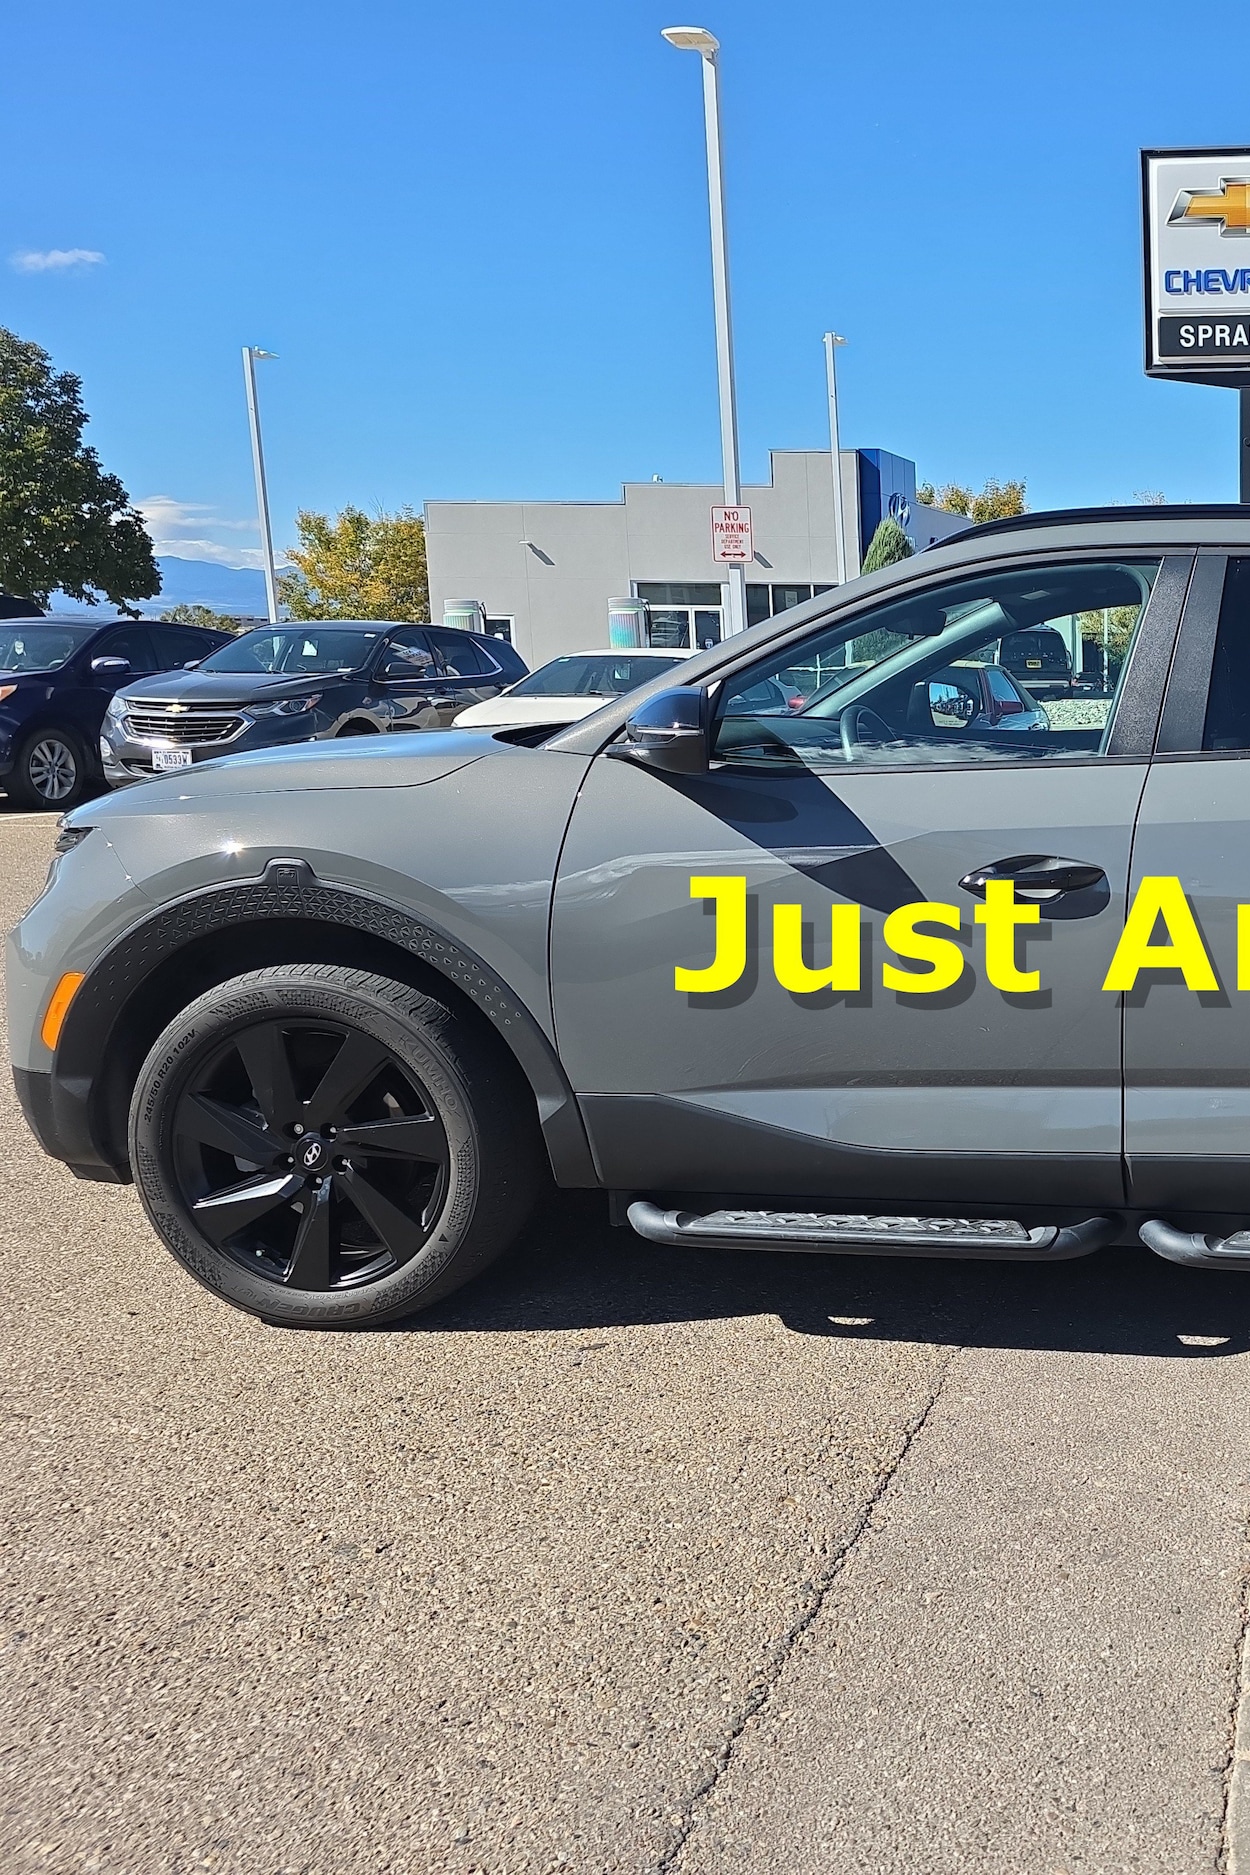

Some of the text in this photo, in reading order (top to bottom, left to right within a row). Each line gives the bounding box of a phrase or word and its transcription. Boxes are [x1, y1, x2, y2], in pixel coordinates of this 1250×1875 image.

[724, 511, 739, 521] NO
[715, 523, 749, 533] PARKING
[144, 1028, 196, 1123] 245/50 R20 102V
[400, 1034, 458, 1111] KUMHO
[258, 1297, 361, 1317] CRUGEN
